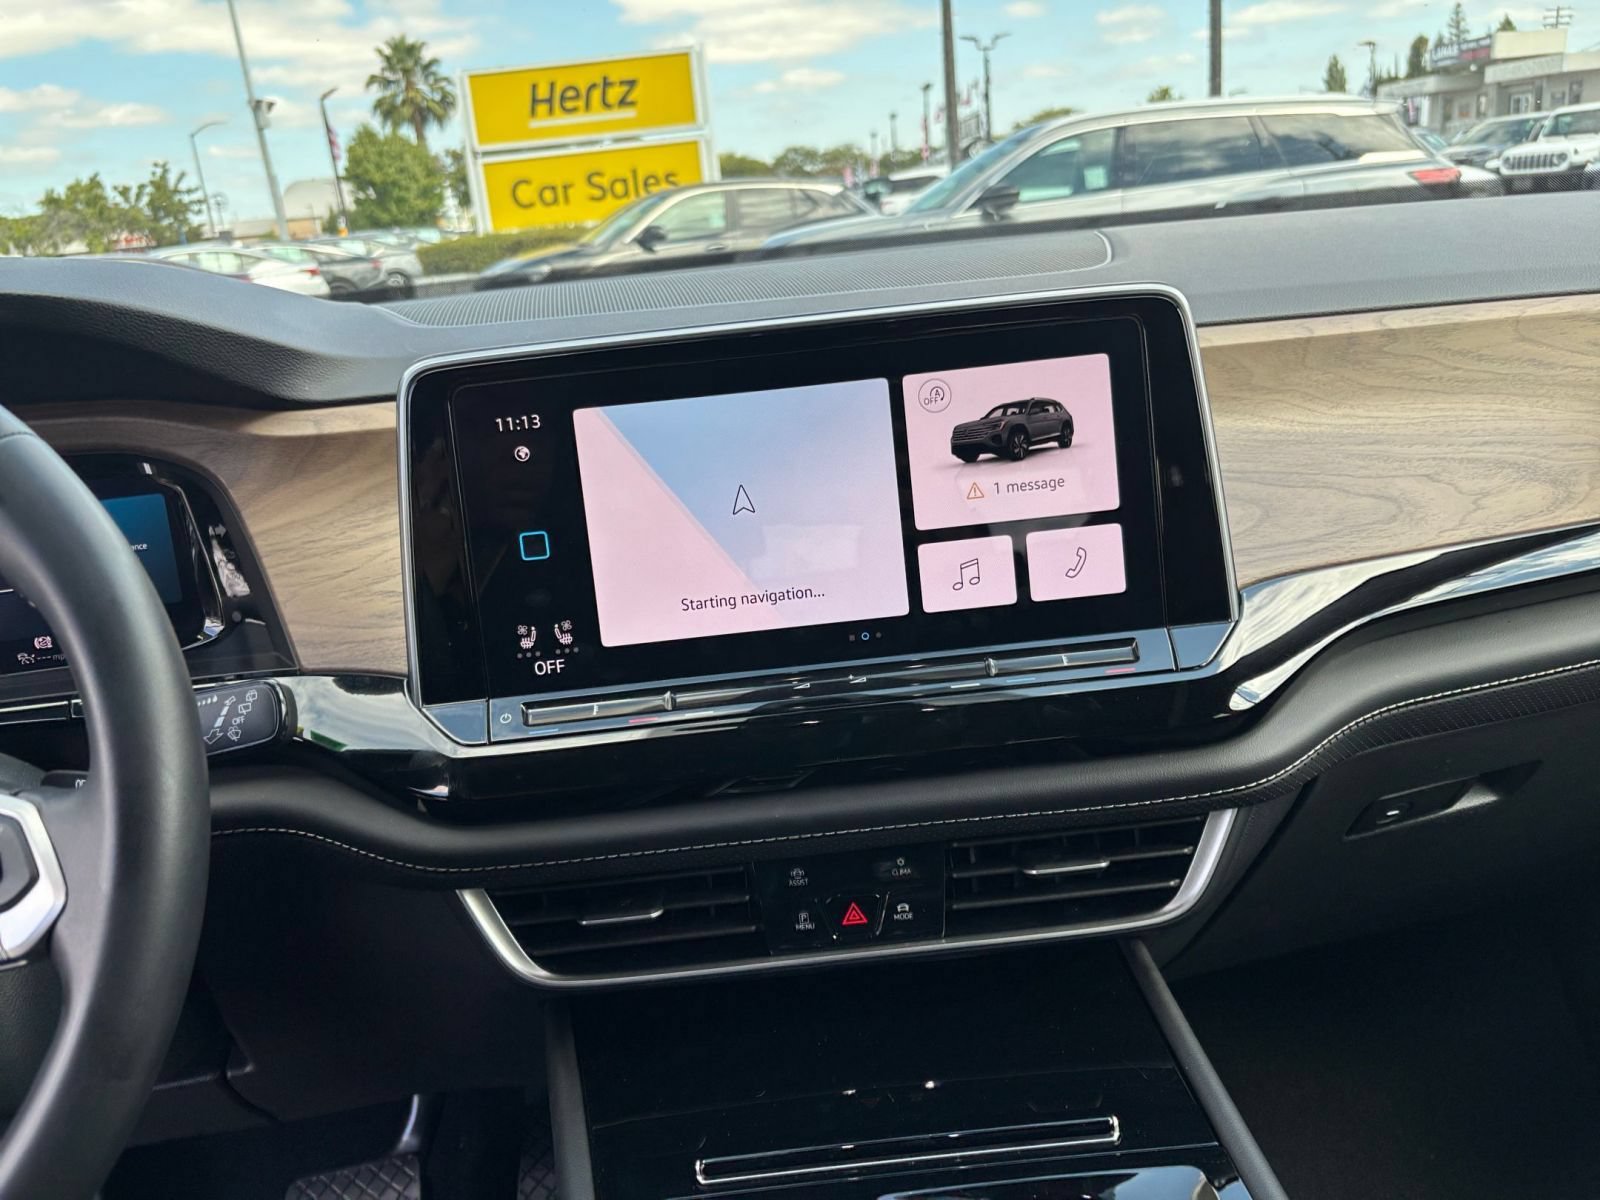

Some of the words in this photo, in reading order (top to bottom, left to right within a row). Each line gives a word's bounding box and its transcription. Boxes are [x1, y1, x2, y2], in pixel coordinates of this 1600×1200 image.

[529, 75, 638, 118] Hertz
[511, 178, 574, 209] Car
[586, 168, 680, 203] Sales
[495, 414, 541, 432] 11:13
[994, 482, 1001, 495] 1
[1006, 476, 1065, 495] message
[681, 595, 737, 612] Starting
[741, 587, 825, 606] navigation...
[534, 659, 566, 676] OFF
[231, 715, 246, 726] OFF
[788, 878, 809, 887] ASSIST
[893, 912, 913, 921] MODE
[795, 923, 816, 932] MENU
